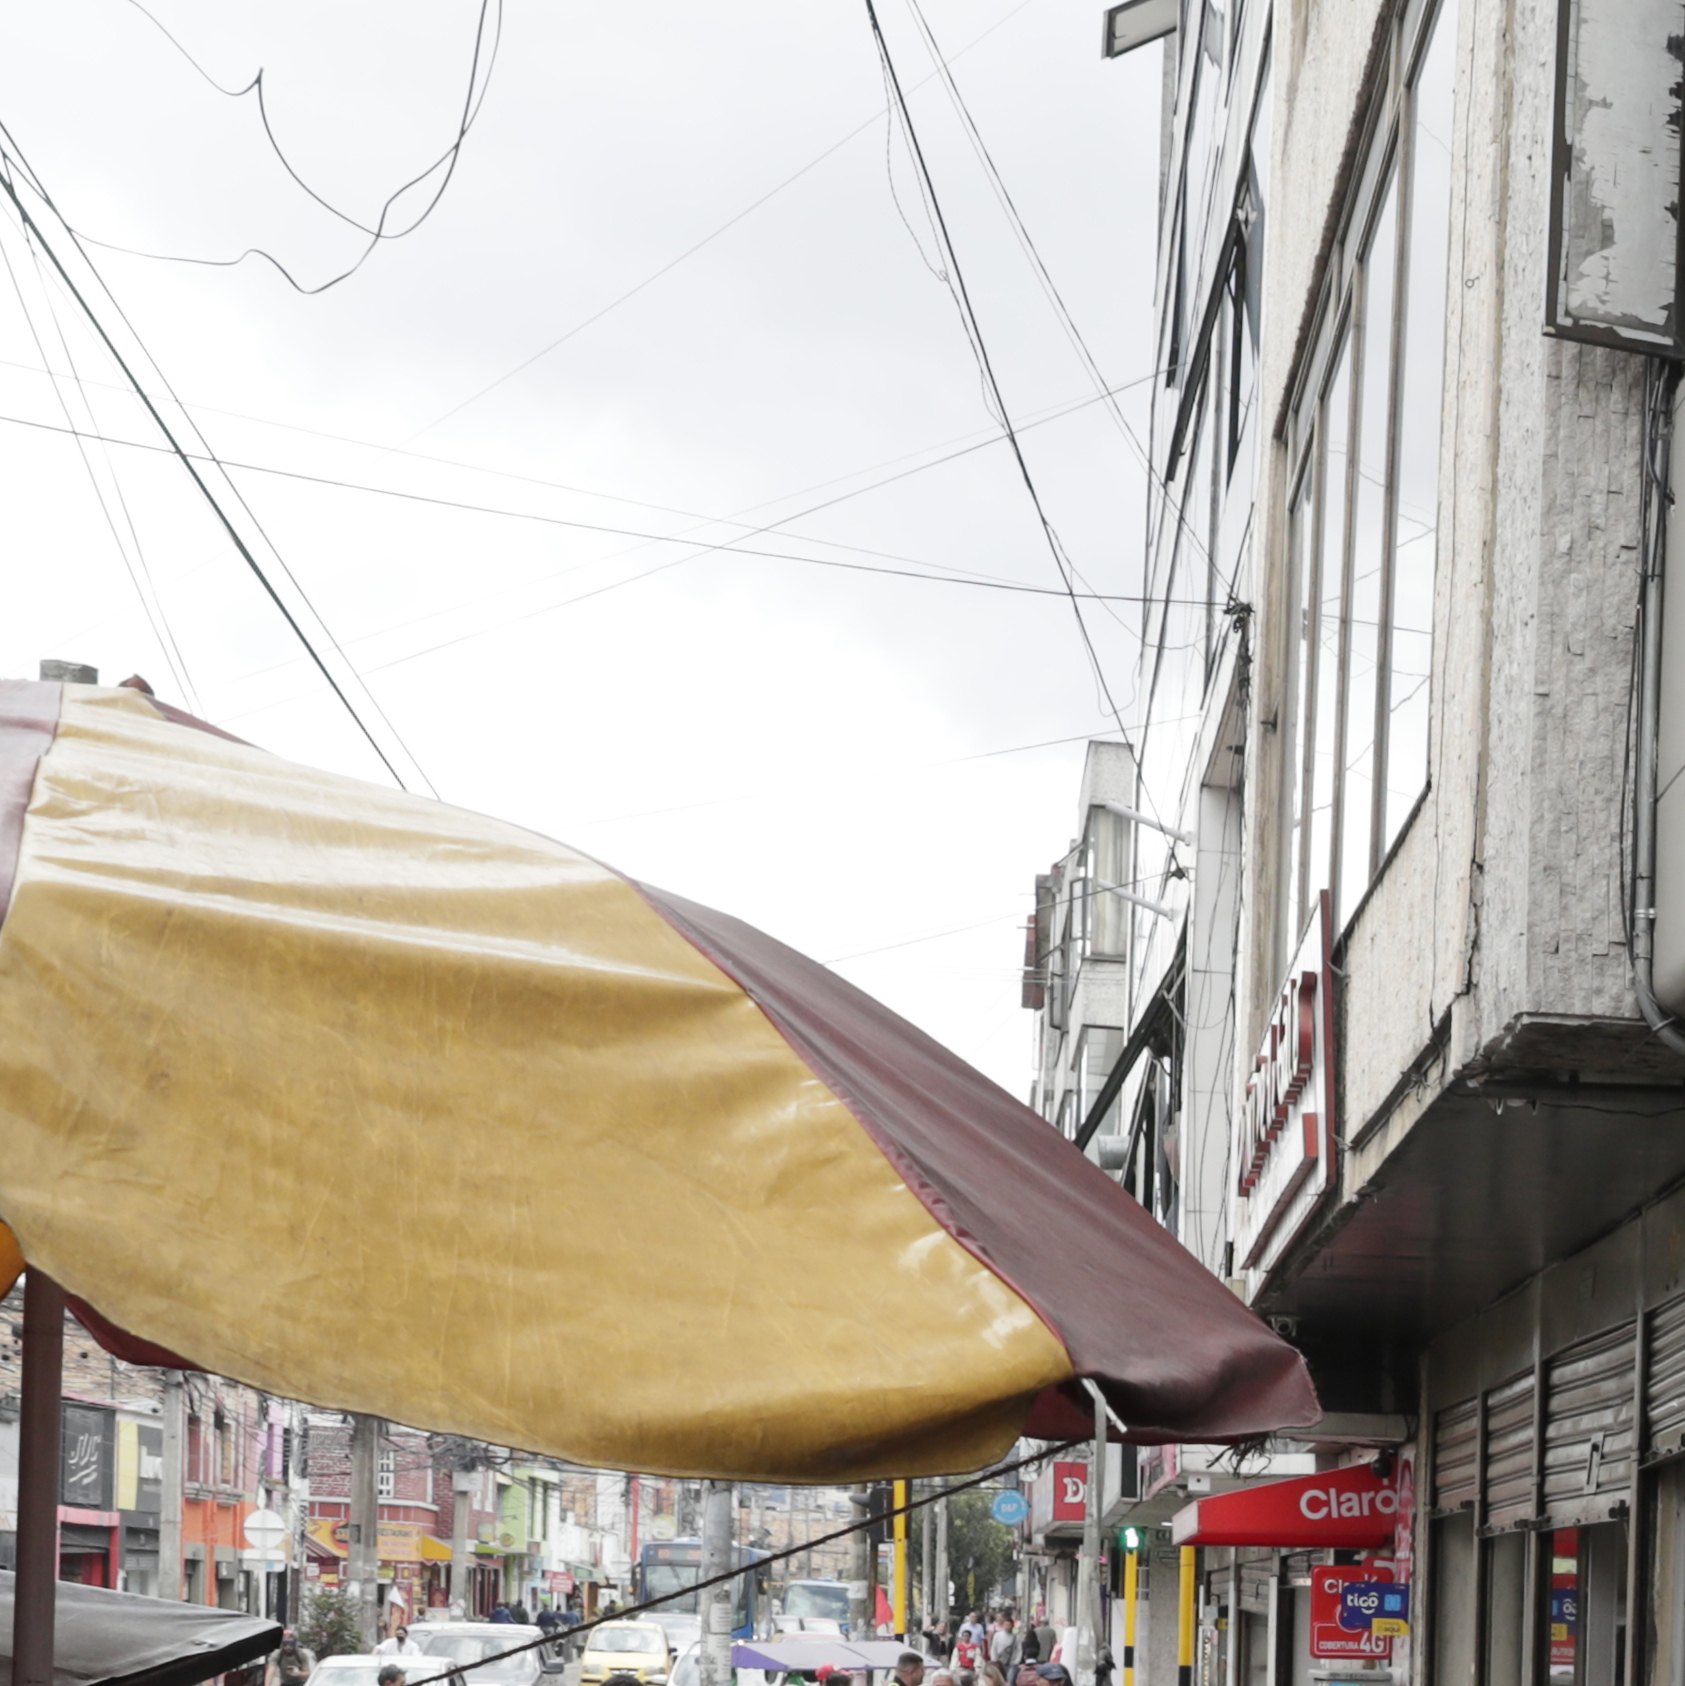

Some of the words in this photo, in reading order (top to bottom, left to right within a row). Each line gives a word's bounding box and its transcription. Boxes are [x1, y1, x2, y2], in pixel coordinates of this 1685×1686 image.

[1299, 1486, 1400, 1521] Claro
[1318, 1640, 1359, 1650] COBERTURA
[1360, 1631, 1385, 1653] 4G
